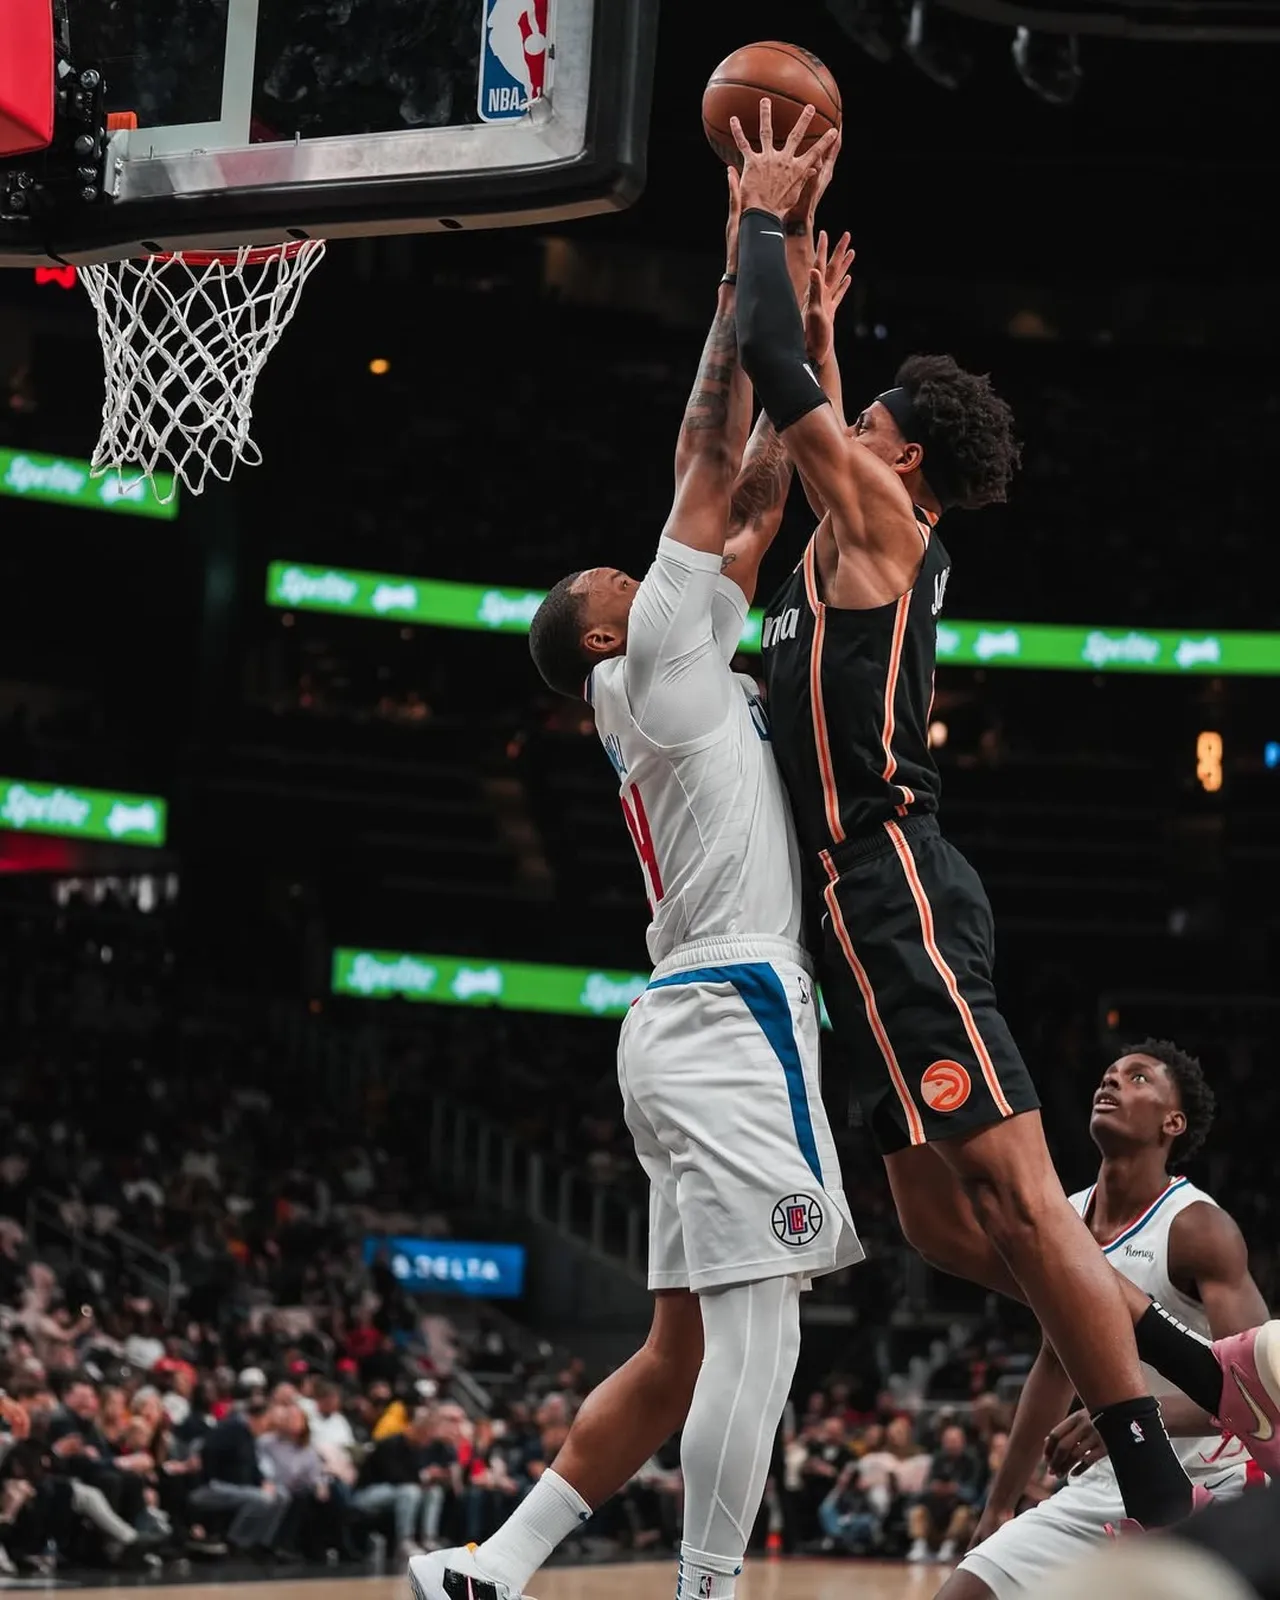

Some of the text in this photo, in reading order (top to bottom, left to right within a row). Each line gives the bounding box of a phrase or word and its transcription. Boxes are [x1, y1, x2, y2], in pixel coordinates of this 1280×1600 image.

[488, 86, 521, 112] NBA
[277, 567, 357, 605] Sprite
[1082, 630, 1160, 668] Sprite
[0, 784, 91, 829] Sprite
[347, 952, 436, 994] Sprite
[1125, 1244, 1154, 1263] honey
